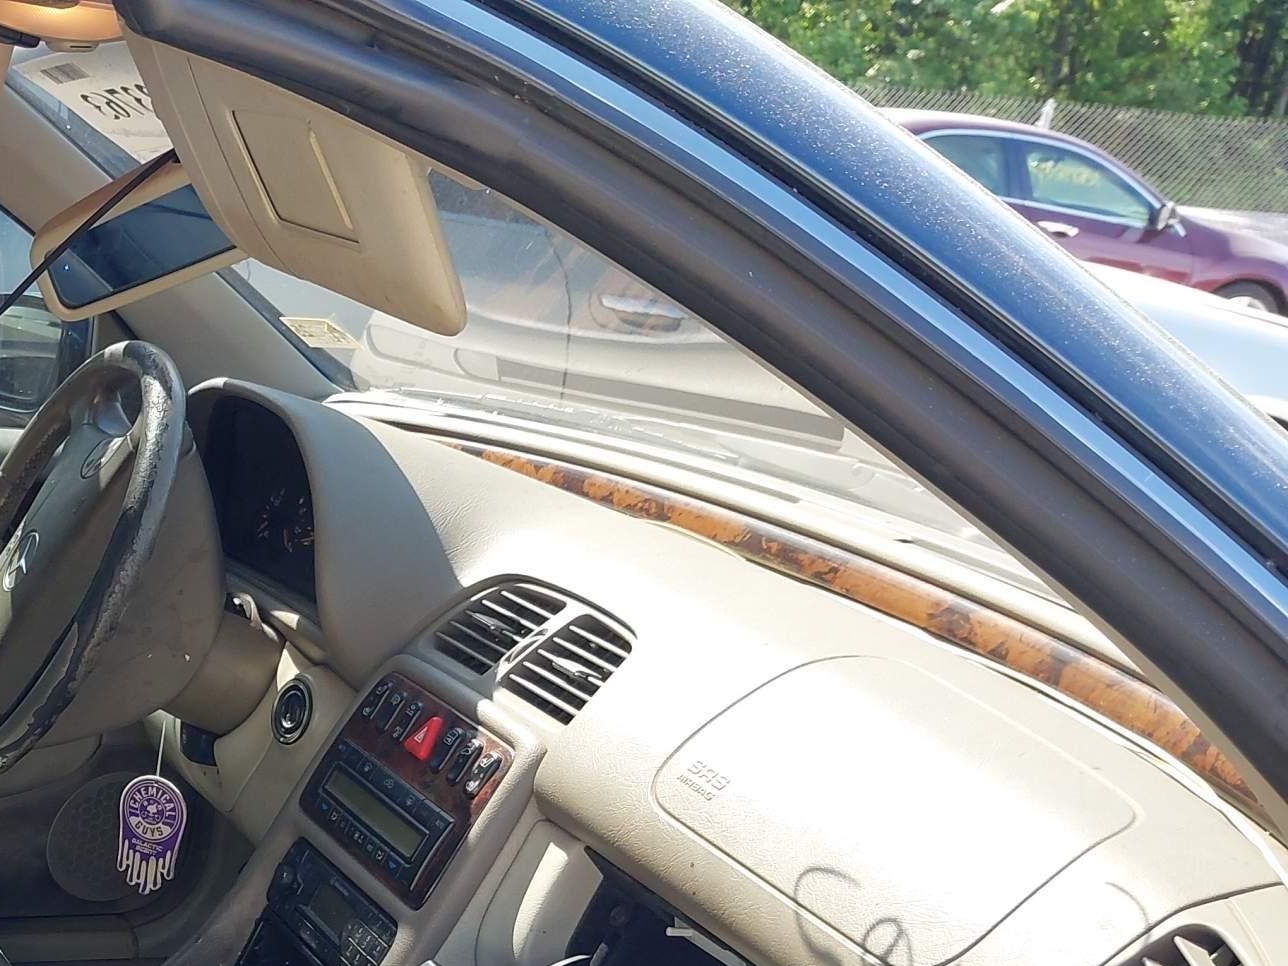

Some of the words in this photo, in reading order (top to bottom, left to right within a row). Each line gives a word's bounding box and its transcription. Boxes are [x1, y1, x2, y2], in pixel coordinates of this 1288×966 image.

[676, 774, 716, 801] AIRBAG
[129, 786, 176, 818] CHEMICAL
[134, 820, 164, 837] GUYS
